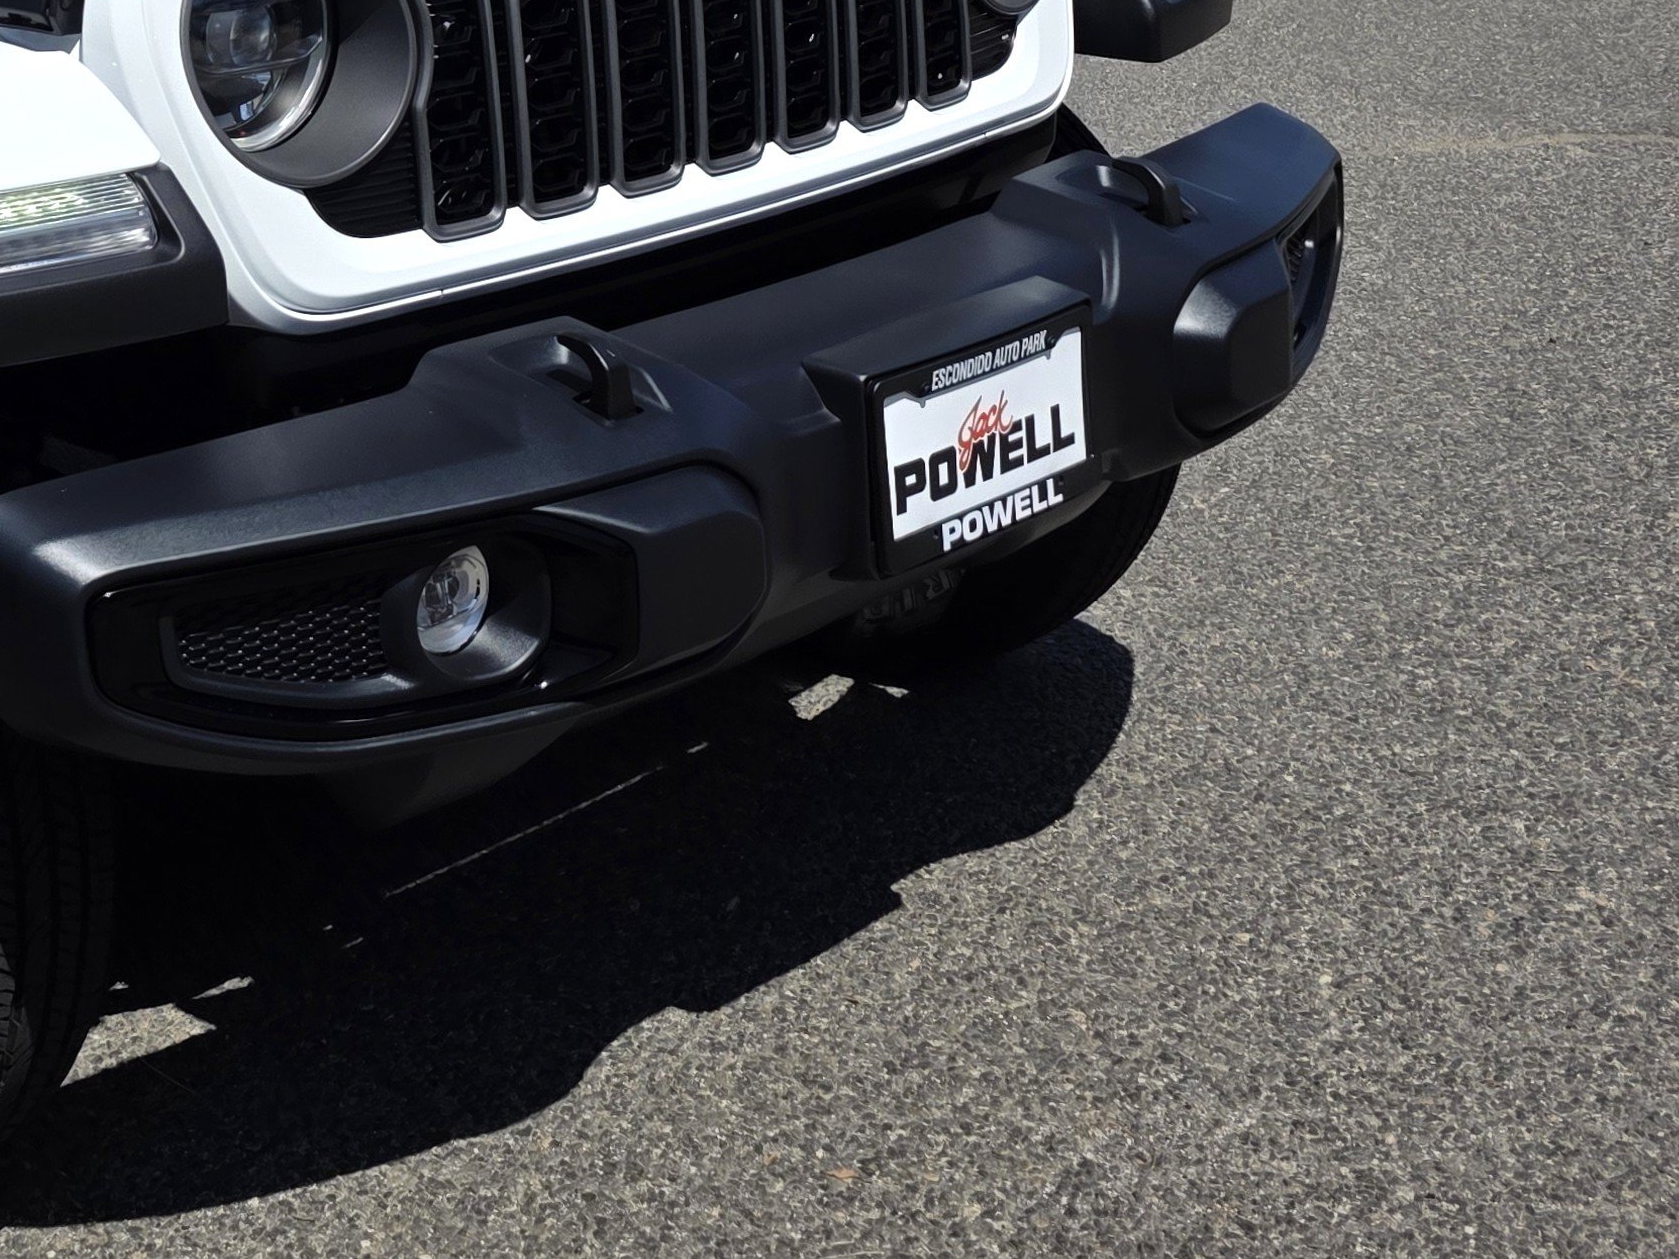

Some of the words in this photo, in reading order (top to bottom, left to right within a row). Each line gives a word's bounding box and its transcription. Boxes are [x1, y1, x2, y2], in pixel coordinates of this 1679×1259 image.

[931, 352, 992, 392] ESCONDIDO
[993, 341, 1020, 368] AUTO
[1021, 329, 1048, 357] PARK
[893, 403, 1076, 517] POWELL
[957, 389, 1014, 474] Jack
[941, 478, 1064, 553] POWELL
